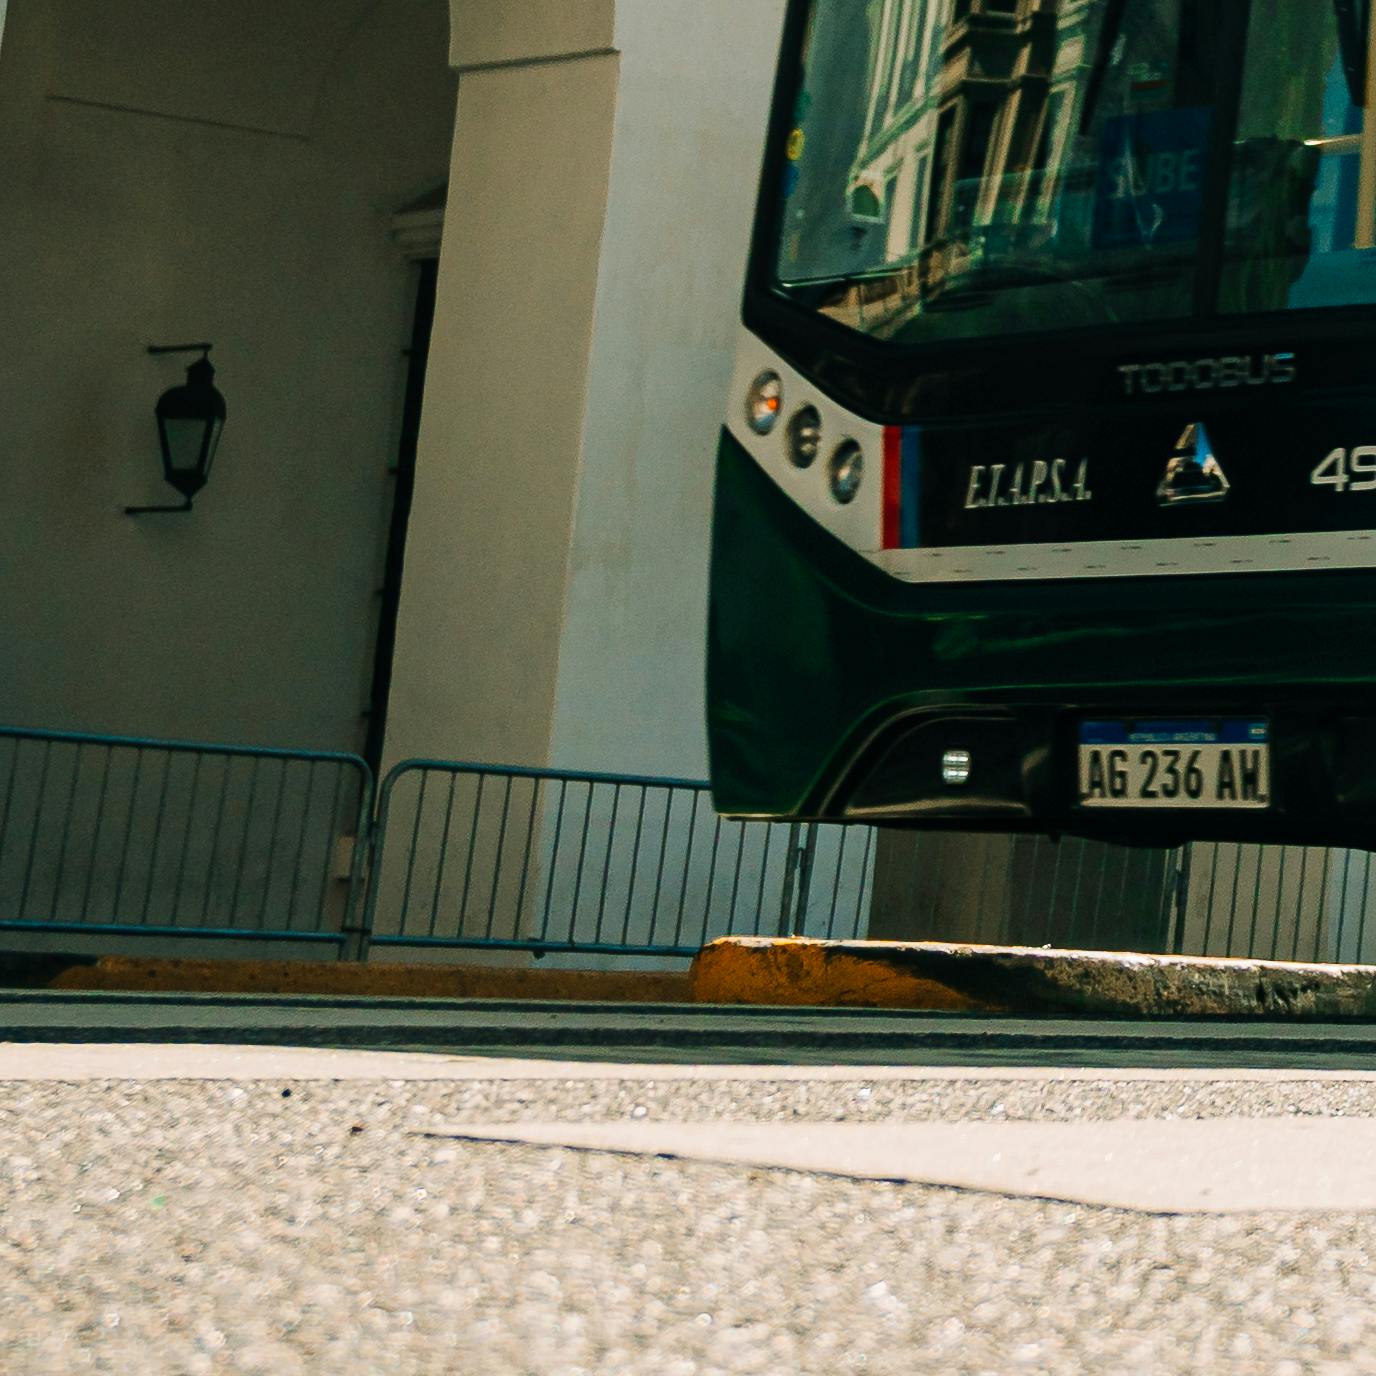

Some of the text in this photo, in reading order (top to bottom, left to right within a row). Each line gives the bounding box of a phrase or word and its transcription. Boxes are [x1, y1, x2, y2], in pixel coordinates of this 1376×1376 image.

[1117, 351, 1297, 396] TODOBUS
[1088, 749, 1128, 799] AG
[1139, 749, 1205, 799] 236
